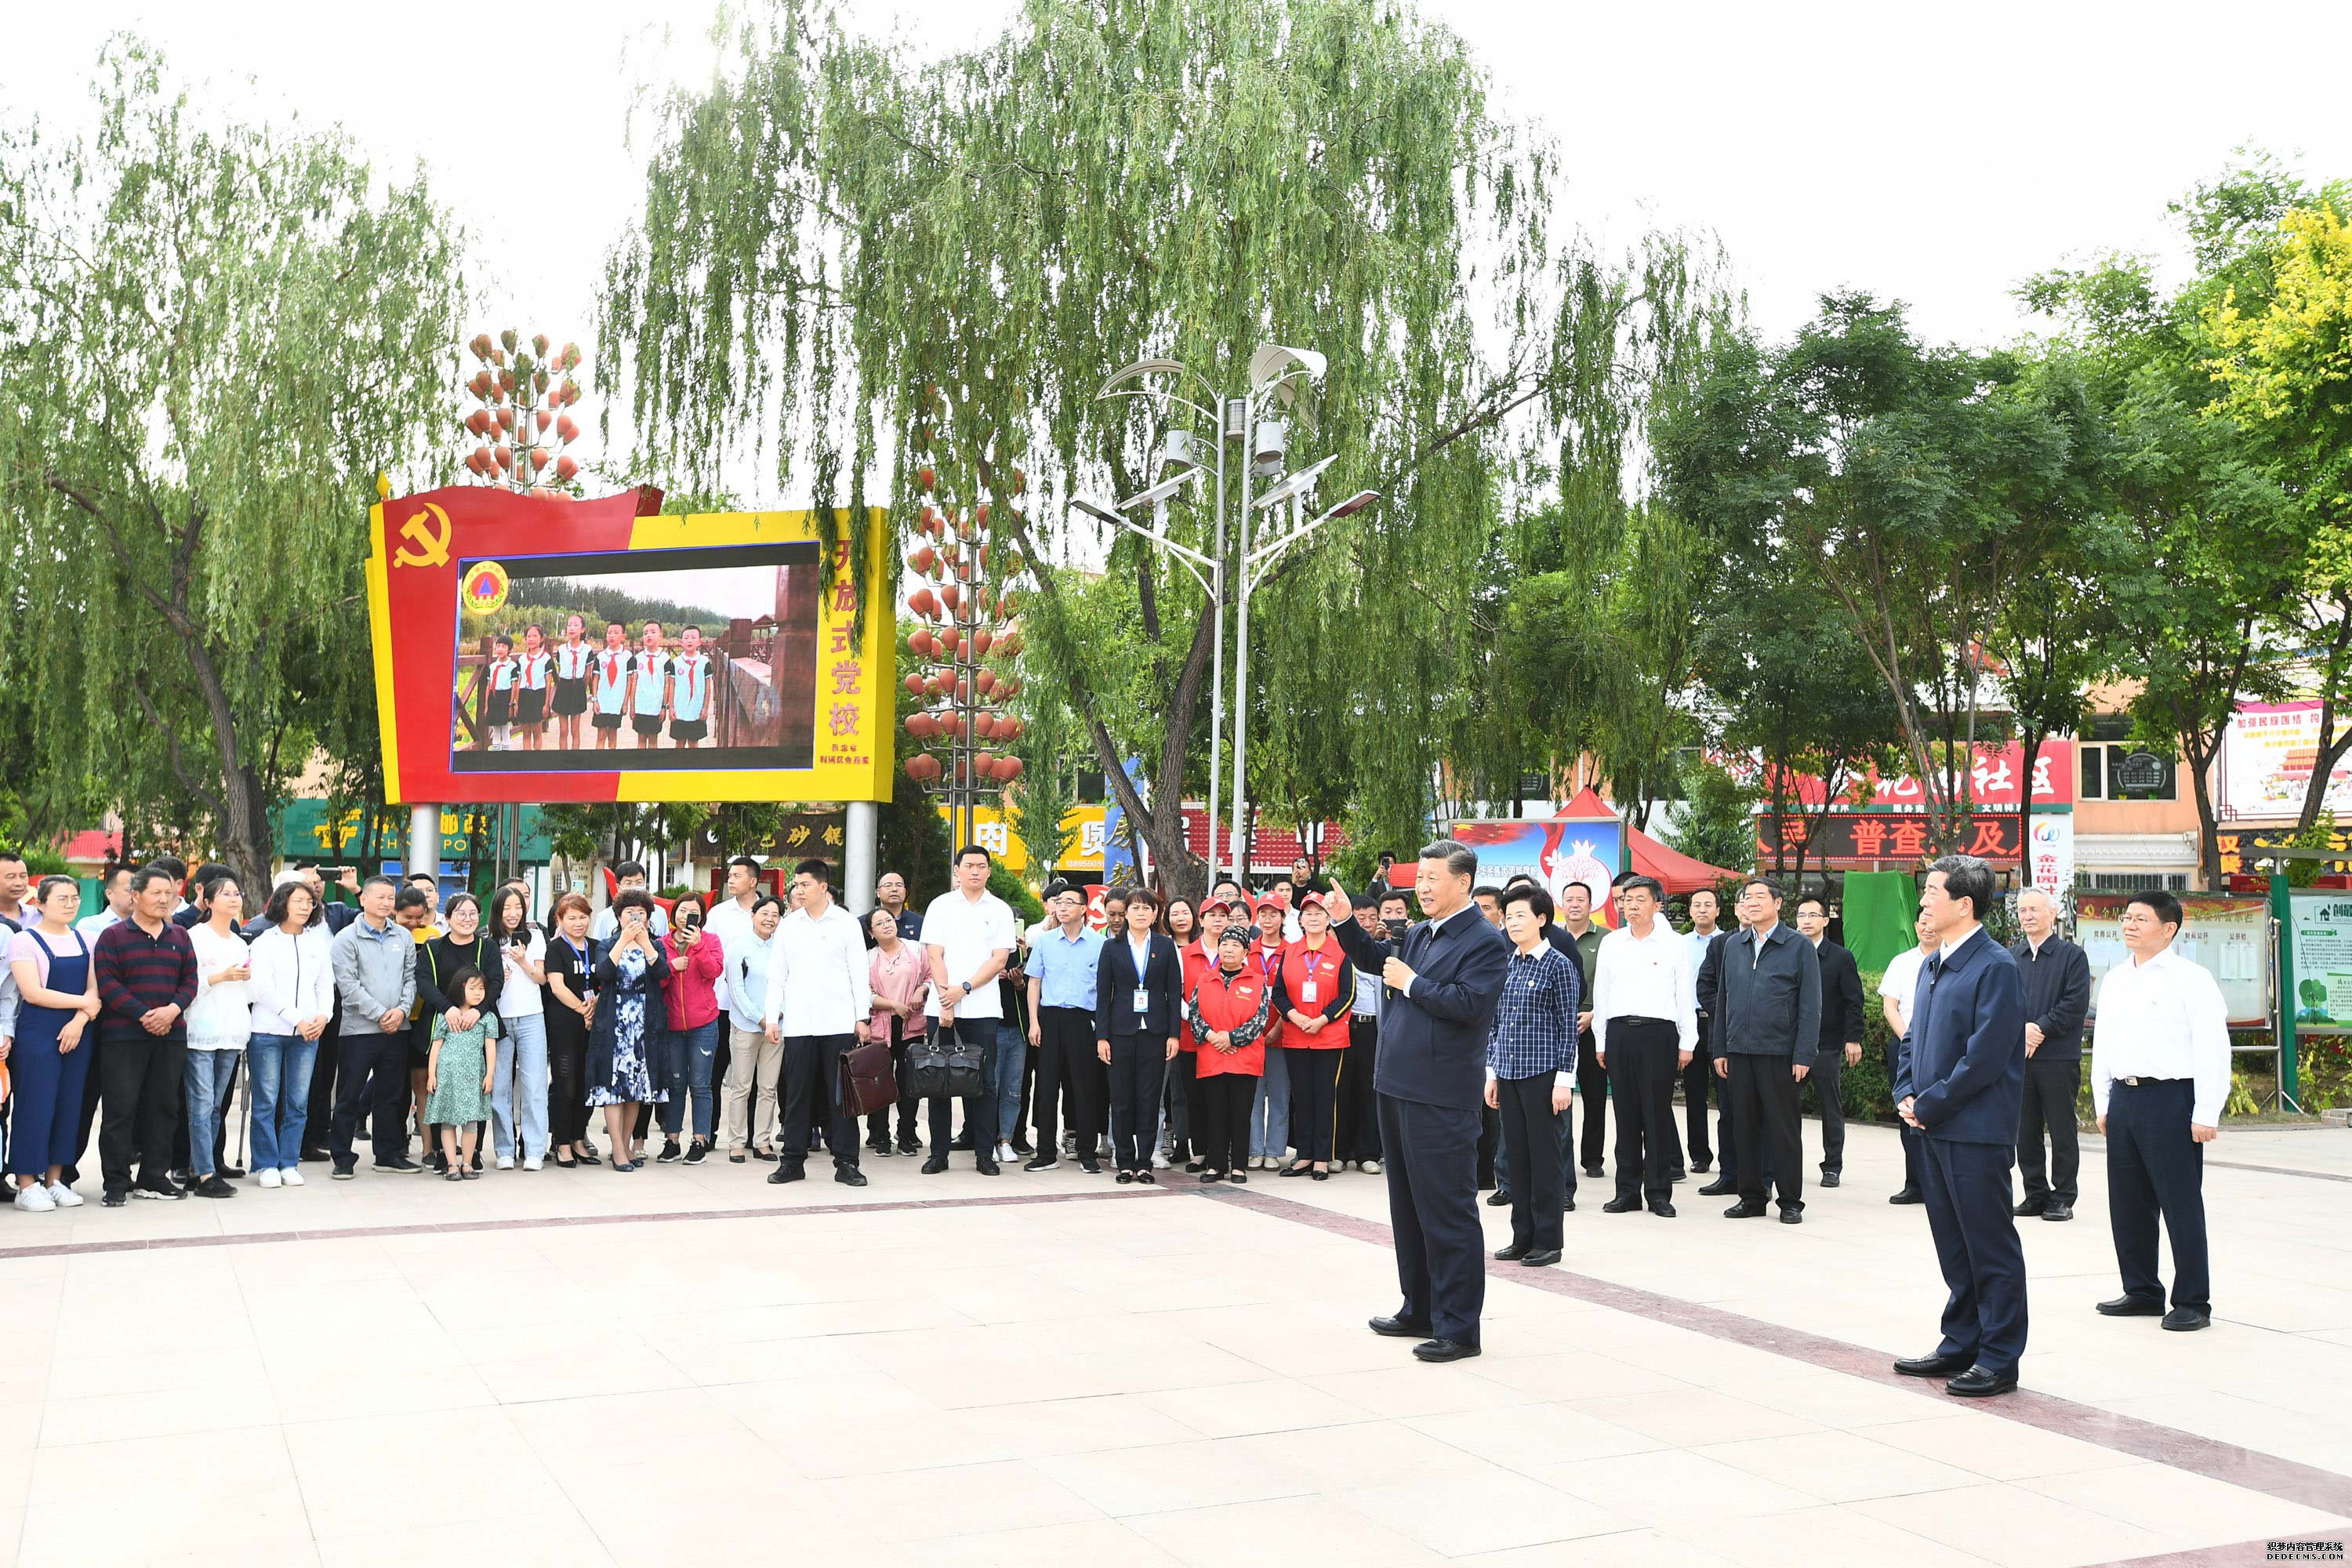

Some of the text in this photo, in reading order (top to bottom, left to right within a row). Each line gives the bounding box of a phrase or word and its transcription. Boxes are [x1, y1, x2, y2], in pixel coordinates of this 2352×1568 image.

[2238, 714, 2301, 728] 加强民族团结
